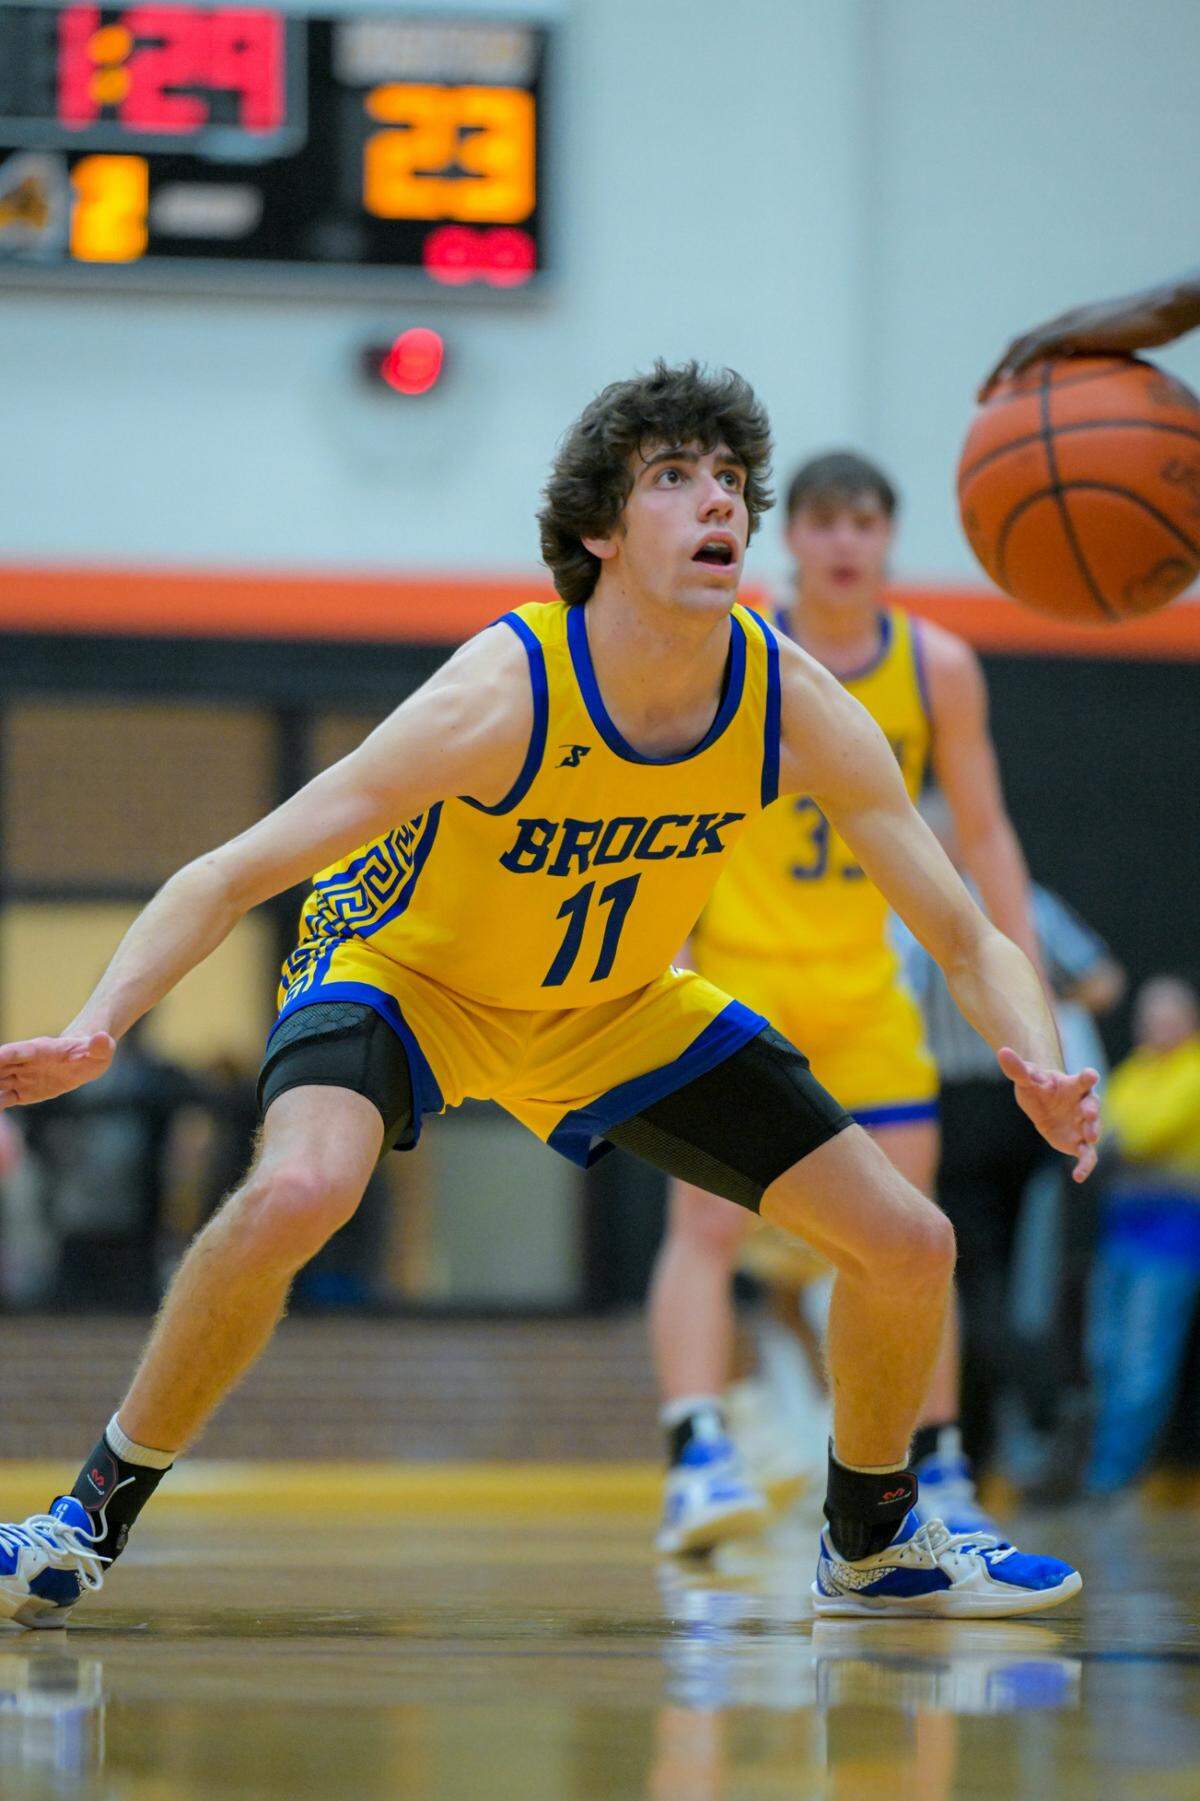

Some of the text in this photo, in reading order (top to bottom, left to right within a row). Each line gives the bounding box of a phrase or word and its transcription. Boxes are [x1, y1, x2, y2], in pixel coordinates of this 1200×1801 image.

[364, 83, 536, 223] 23
[499, 812, 746, 877] BROCK
[541, 873, 642, 987] 11
